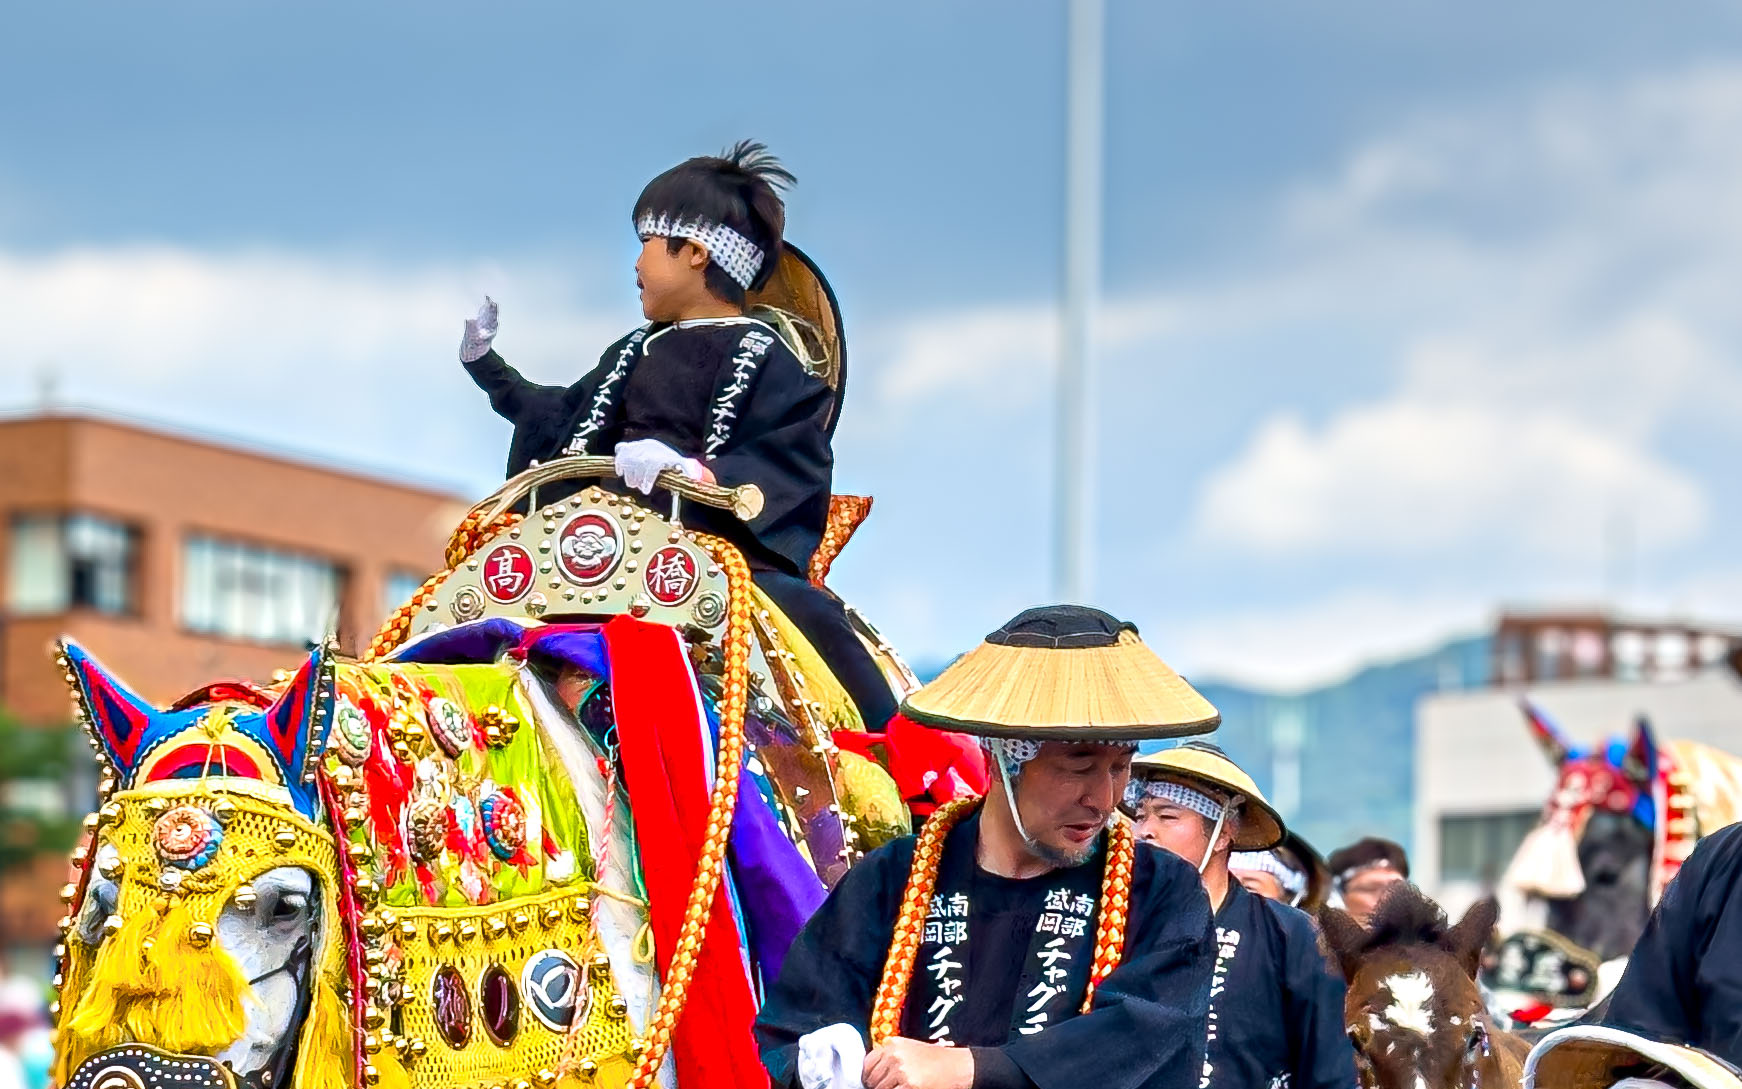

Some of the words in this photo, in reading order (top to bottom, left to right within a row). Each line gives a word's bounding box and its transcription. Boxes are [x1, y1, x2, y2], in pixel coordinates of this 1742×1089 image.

[705, 351, 757, 461] チャグチャグ
